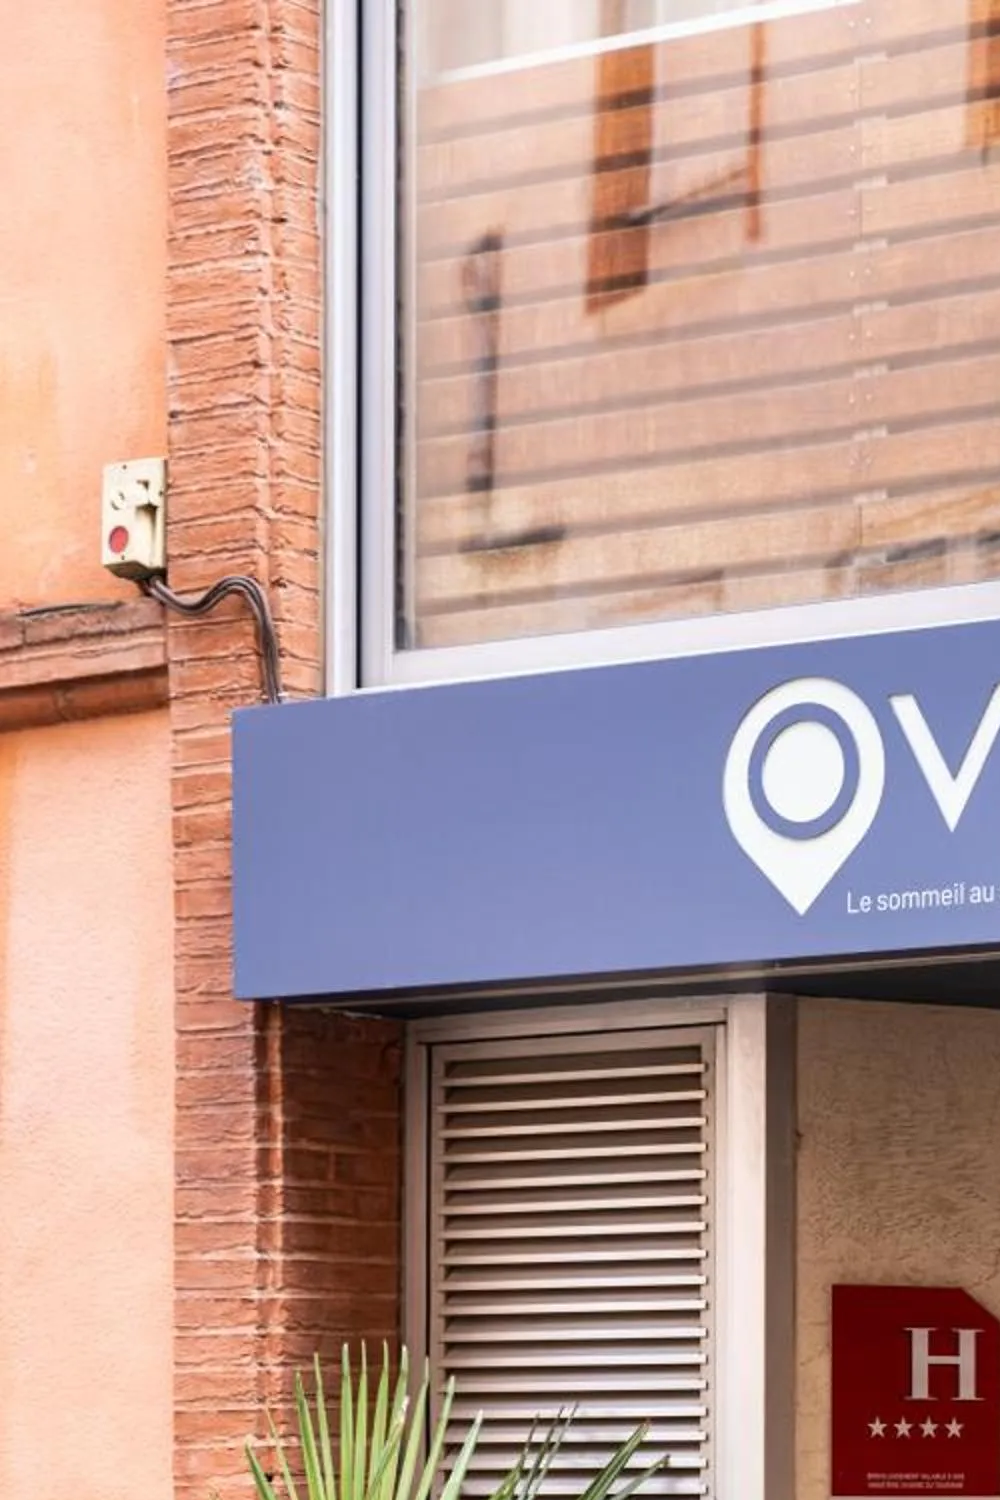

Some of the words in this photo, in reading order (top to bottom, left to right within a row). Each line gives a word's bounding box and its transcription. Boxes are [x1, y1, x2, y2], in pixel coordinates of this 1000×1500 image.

[847, 891, 872, 914] Le
[877, 881, 965, 911] sommeil
[969, 884, 995, 904] au
[903, 1327, 985, 1401] H
